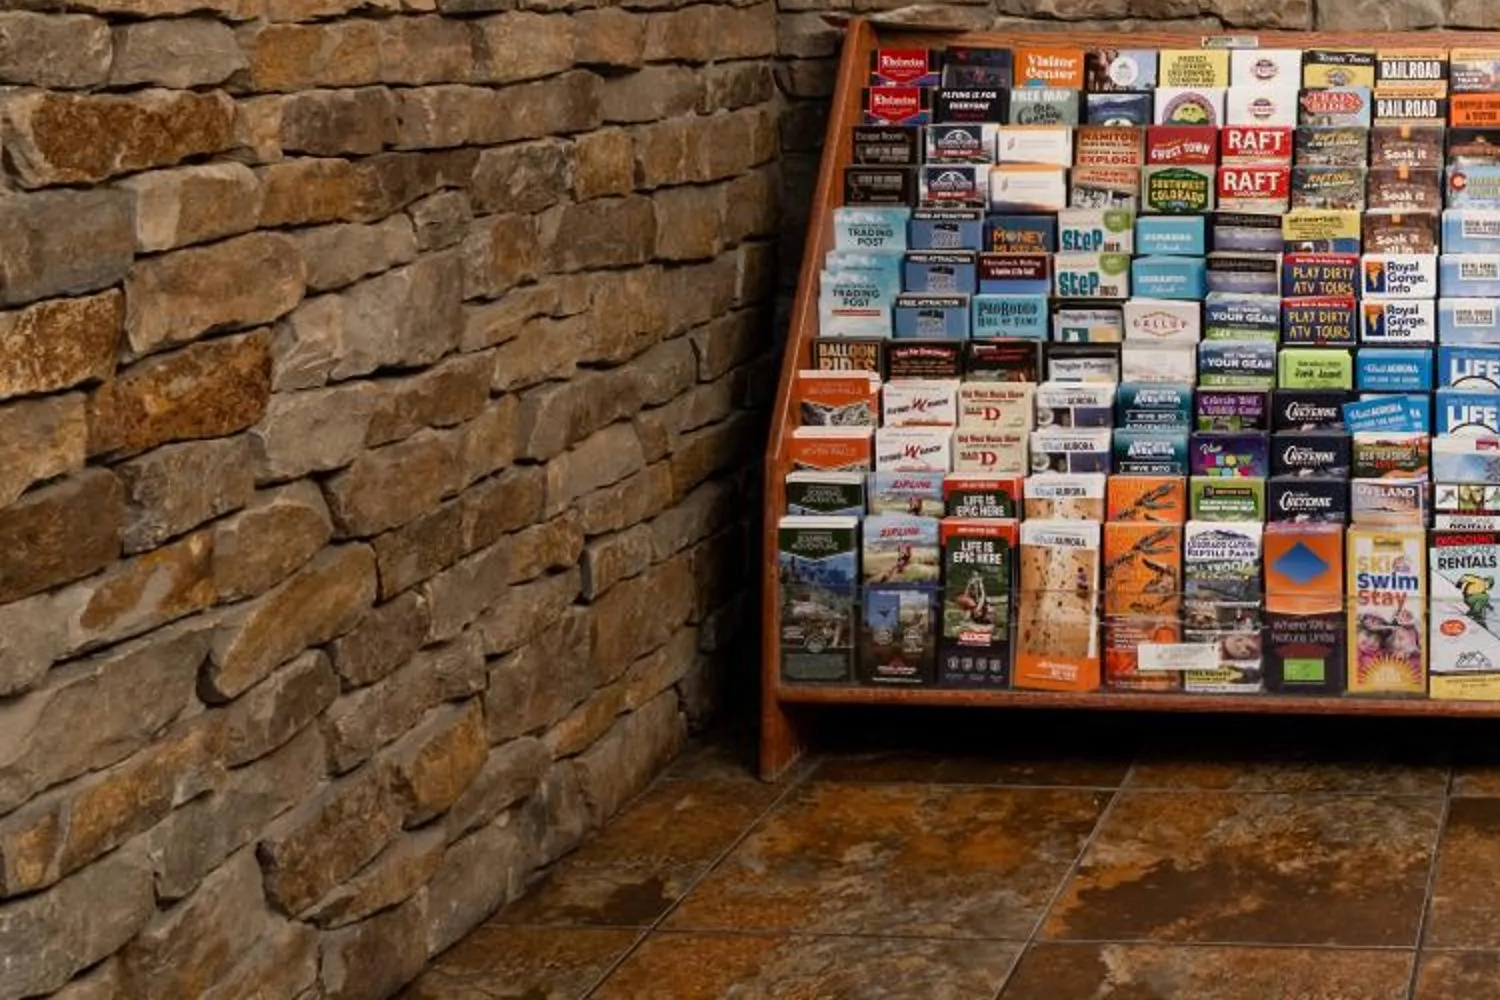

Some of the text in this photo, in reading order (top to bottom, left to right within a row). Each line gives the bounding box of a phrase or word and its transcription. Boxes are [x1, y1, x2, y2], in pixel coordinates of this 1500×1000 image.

[1382, 61, 1440, 79] RAILROAD
[1377, 101, 1437, 117] RAILROAD
[1228, 131, 1285, 150] RAFT
[1384, 149, 1427, 160] Soak it
[1223, 172, 1280, 191] RAFT
[1381, 190, 1412, 201] Soak
[848, 229, 894, 238] TRADING
[993, 228, 1046, 243] MONEY
[857, 237, 884, 247] POST
[1323, 267, 1354, 279] DIRTY
[1387, 262, 1419, 274] Royal
[1387, 273, 1428, 286] Gorge.
[832, 289, 880, 298] TRADING
[1293, 282, 1353, 294] ATV TOURS
[1387, 283, 1411, 293] info
[843, 298, 870, 307] POST
[1387, 304, 1419, 317] Royal
[1319, 311, 1351, 323] DIRTY
[1289, 327, 1349, 339] ATV TOURS
[1387, 326, 1411, 337] info
[819, 344, 876, 357] BALLOON
[1208, 359, 1239, 368] YOUR
[1450, 358, 1500, 387] LIFE
[1447, 406, 1499, 434] LIFE
[963, 495, 984, 505] LIFE
[956, 505, 1004, 517] EPIC HERE
[961, 541, 994, 553] LIFE IS
[953, 552, 976, 563] EPIC
[1437, 556, 1497, 569] RENTALS
[1357, 573, 1419, 590] Swim
[1358, 589, 1407, 612] Stay
